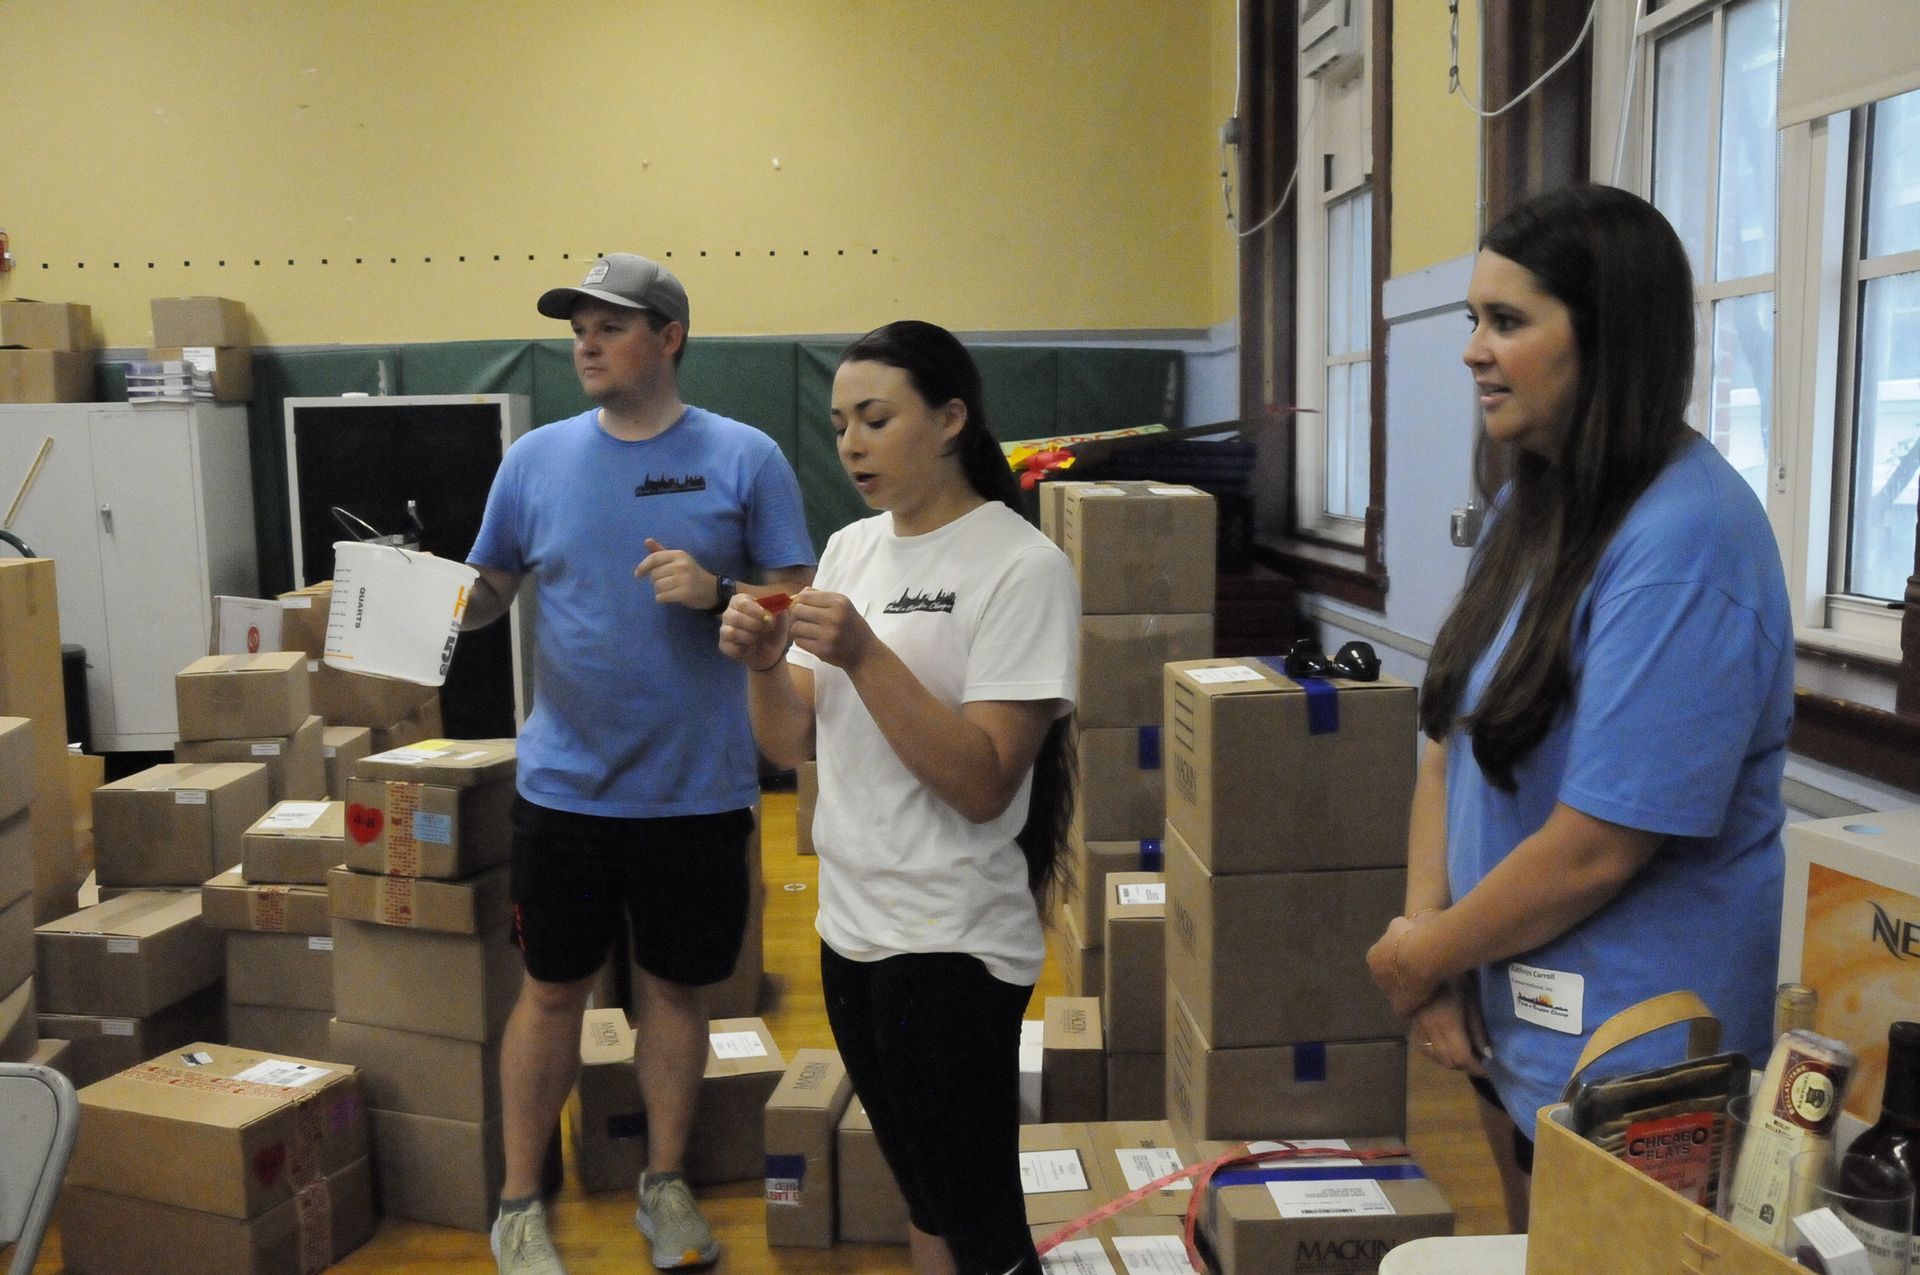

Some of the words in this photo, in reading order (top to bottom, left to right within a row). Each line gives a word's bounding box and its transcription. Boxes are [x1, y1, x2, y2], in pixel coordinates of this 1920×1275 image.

[354, 587, 366, 629] QUARTS
[1866, 900, 1920, 961] NE
[1533, 971, 1555, 980] Carroll
[1628, 1126, 1709, 1158] CHICAGO
[1646, 1145, 1691, 1161] FLATS
[1297, 1239, 1396, 1261] MACKIN
